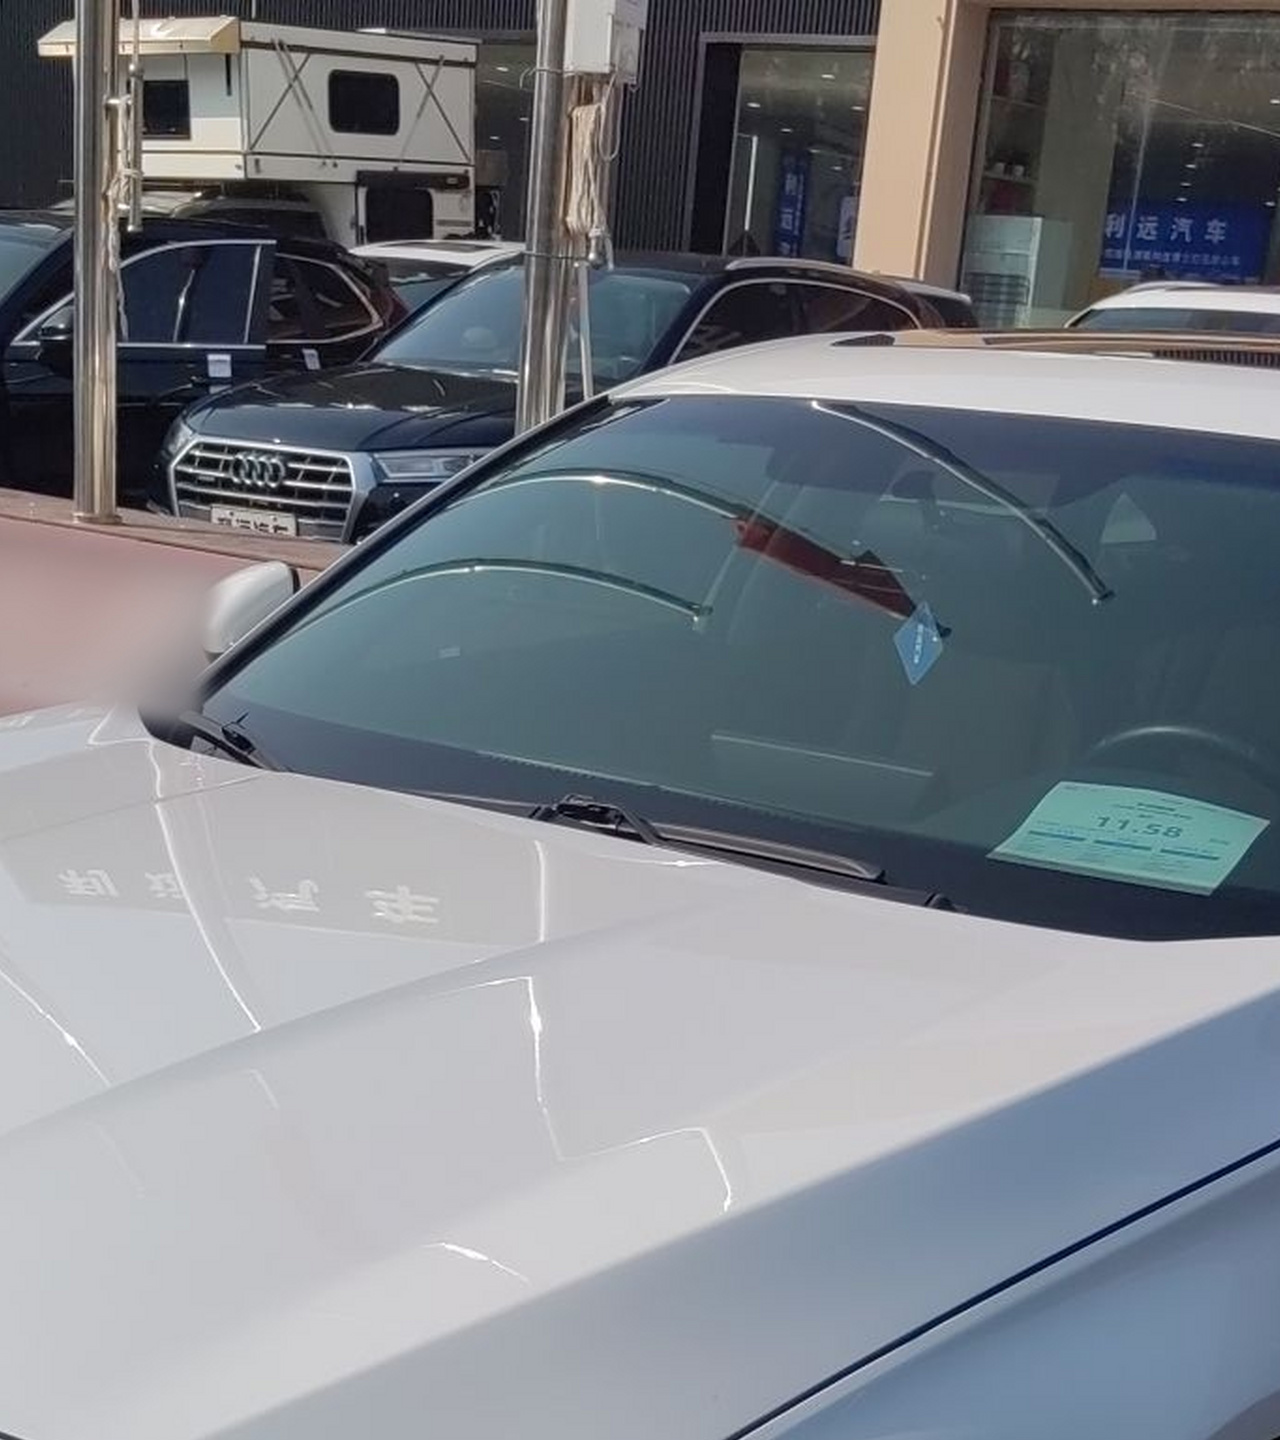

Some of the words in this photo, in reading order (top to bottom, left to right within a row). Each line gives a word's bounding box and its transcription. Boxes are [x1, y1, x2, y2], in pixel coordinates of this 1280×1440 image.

[1105, 213, 1228, 244] 利远汽车
[1097, 816, 1183, 839] 11.58
